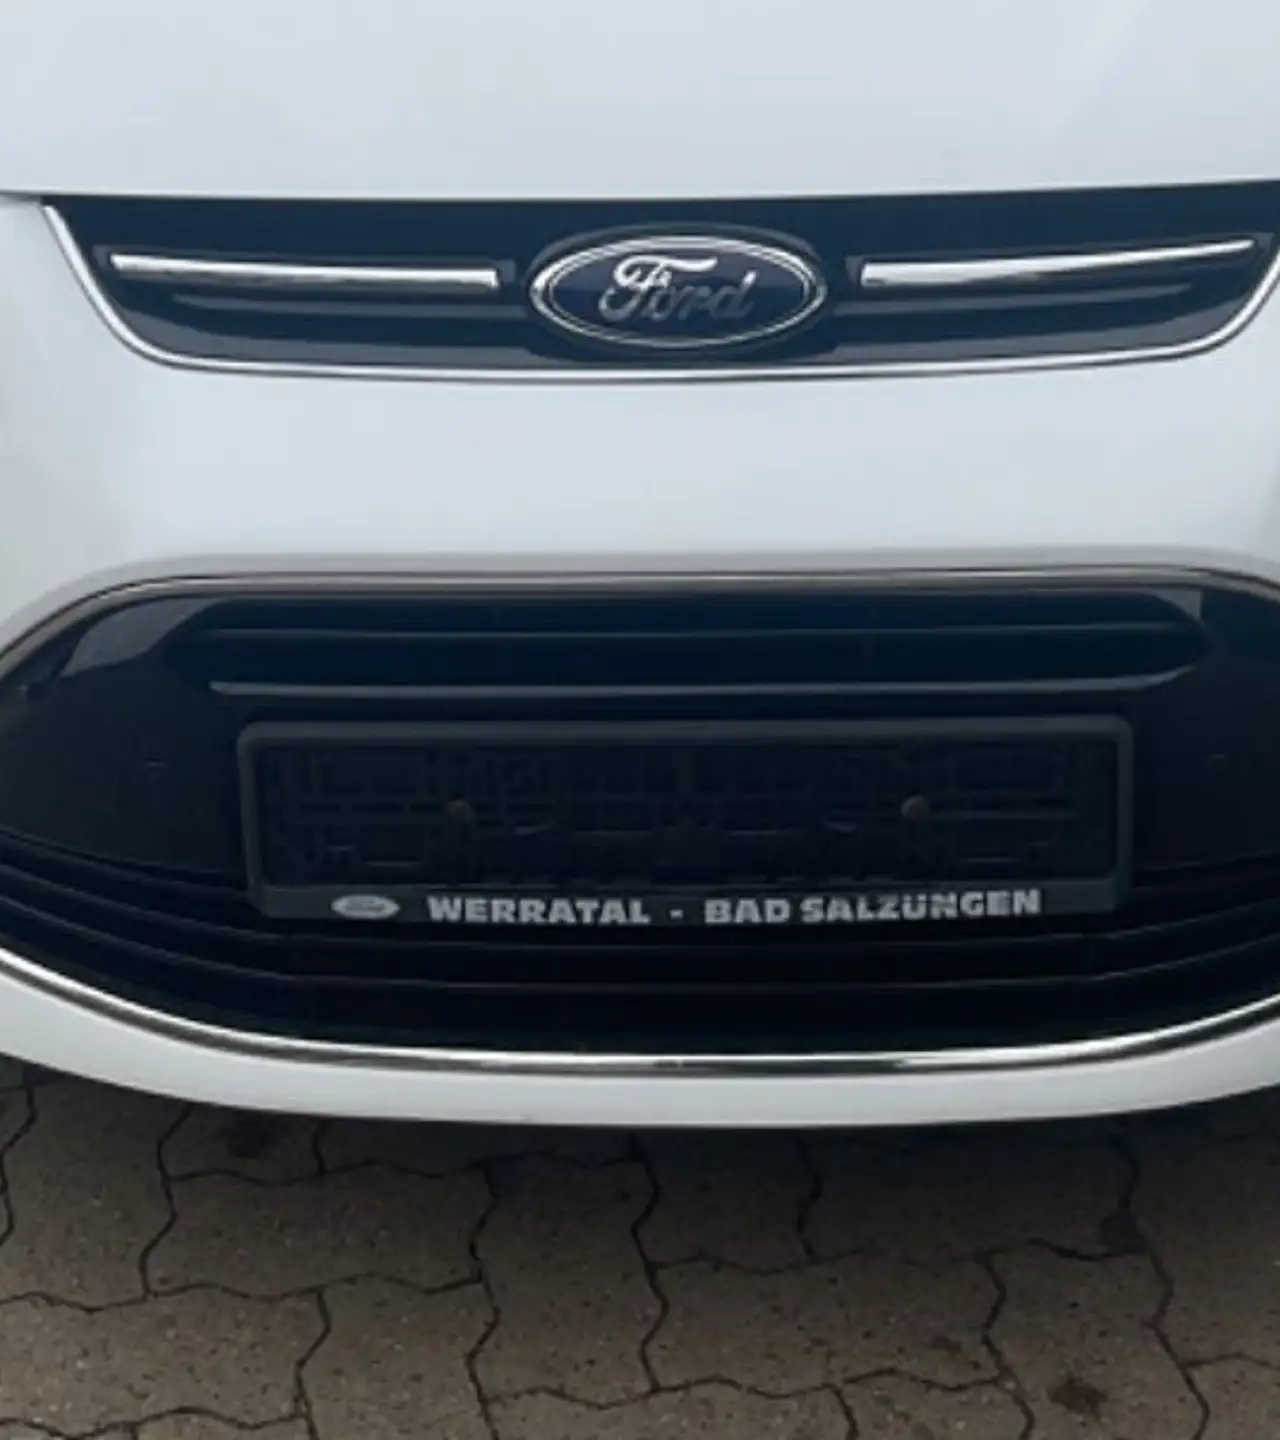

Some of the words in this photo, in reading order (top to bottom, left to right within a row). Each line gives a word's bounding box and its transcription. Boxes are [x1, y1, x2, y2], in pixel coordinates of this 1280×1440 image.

[597, 254, 757, 321] Ford
[426, 895, 651, 925] WERRATAL
[704, 898, 792, 925] BAD
